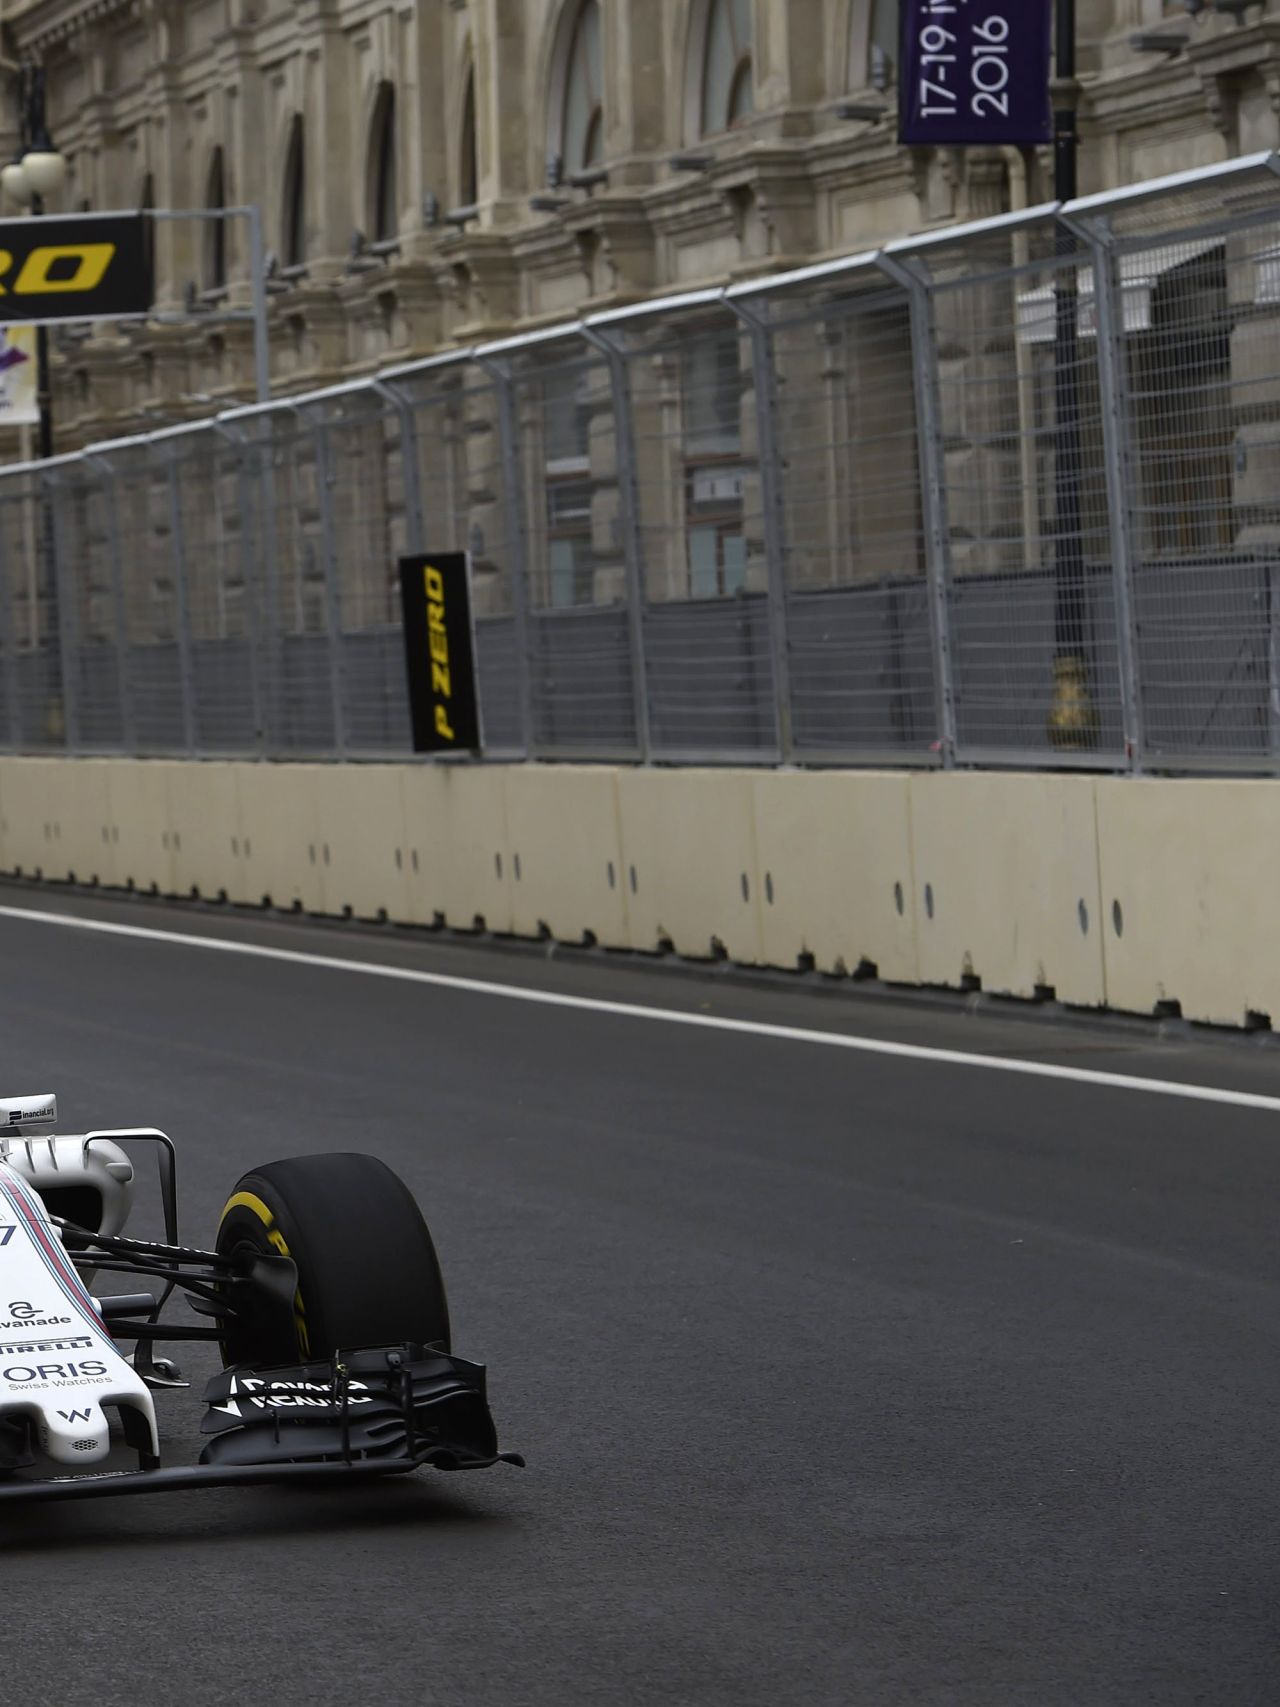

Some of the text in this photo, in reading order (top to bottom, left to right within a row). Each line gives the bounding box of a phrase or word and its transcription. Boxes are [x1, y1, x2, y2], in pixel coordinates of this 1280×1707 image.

[920, 25, 957, 118] 17-19
[972, 15, 1009, 117] 2016
[424, 565, 455, 740] P ZERO
[3, 1360, 108, 1382] ORIS
[8, 1376, 113, 1391] Swiss Watches
